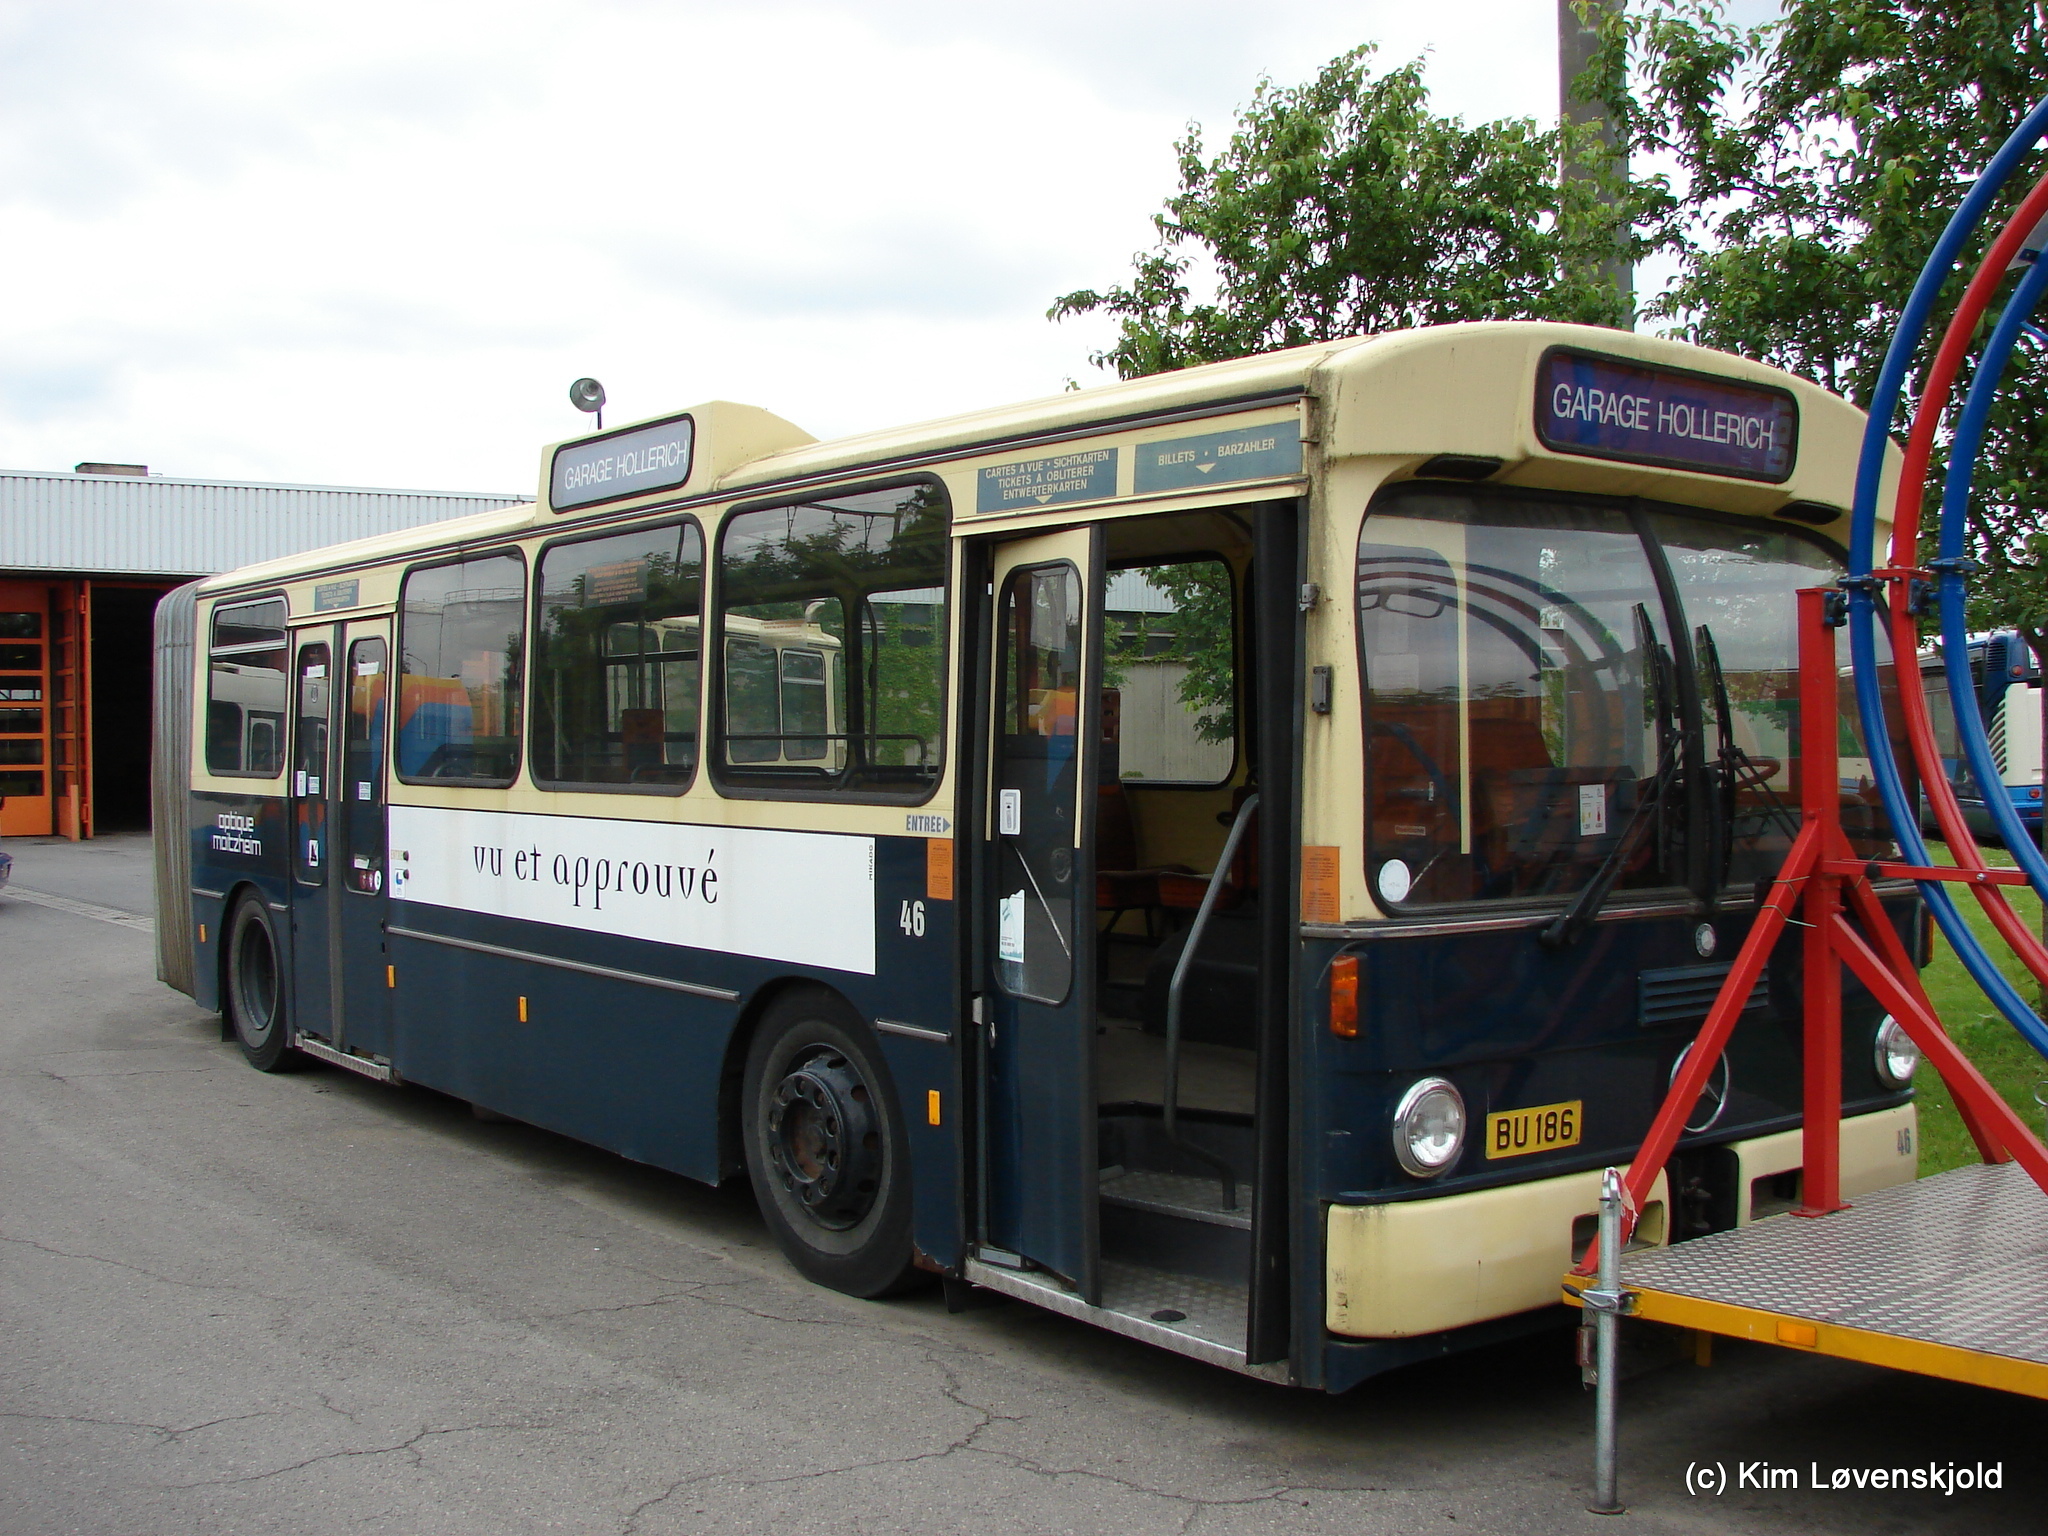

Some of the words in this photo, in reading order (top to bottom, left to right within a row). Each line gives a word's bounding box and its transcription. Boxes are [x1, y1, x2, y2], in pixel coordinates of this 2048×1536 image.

[1552, 383, 1650, 431] GARAGE
[1657, 401, 1774, 450] HOLLERICH
[564, 457, 613, 490] GARAGE
[616, 439, 687, 478] HOLLERICH
[985, 464, 1016, 479] CARTES
[1019, 463, 1025, 474] A
[1027, 460, 1044, 472] VUE
[1053, 450, 1110, 469] SICHTKARTEN
[1158, 451, 1195, 466] BILLETS
[1217, 439, 1275, 457] BARZAHLER
[998, 474, 1032, 489] TICKETS
[1036, 473, 1042, 483] A
[1046, 465, 1095, 482] OBLITERER
[1003, 478, 1088, 500] ENTWERTERKARTEN
[218, 810, 254, 835] optique
[905, 814, 942, 833] ENTRÉE
[473, 845, 503, 877] vu
[514, 843, 542, 881] et
[553, 848, 718, 910] approuvé
[900, 900, 925, 937] 46
[1496, 1115, 1528, 1151] BU
[1535, 1108, 1574, 1145] 186
[1896, 1127, 1911, 1156] 46
